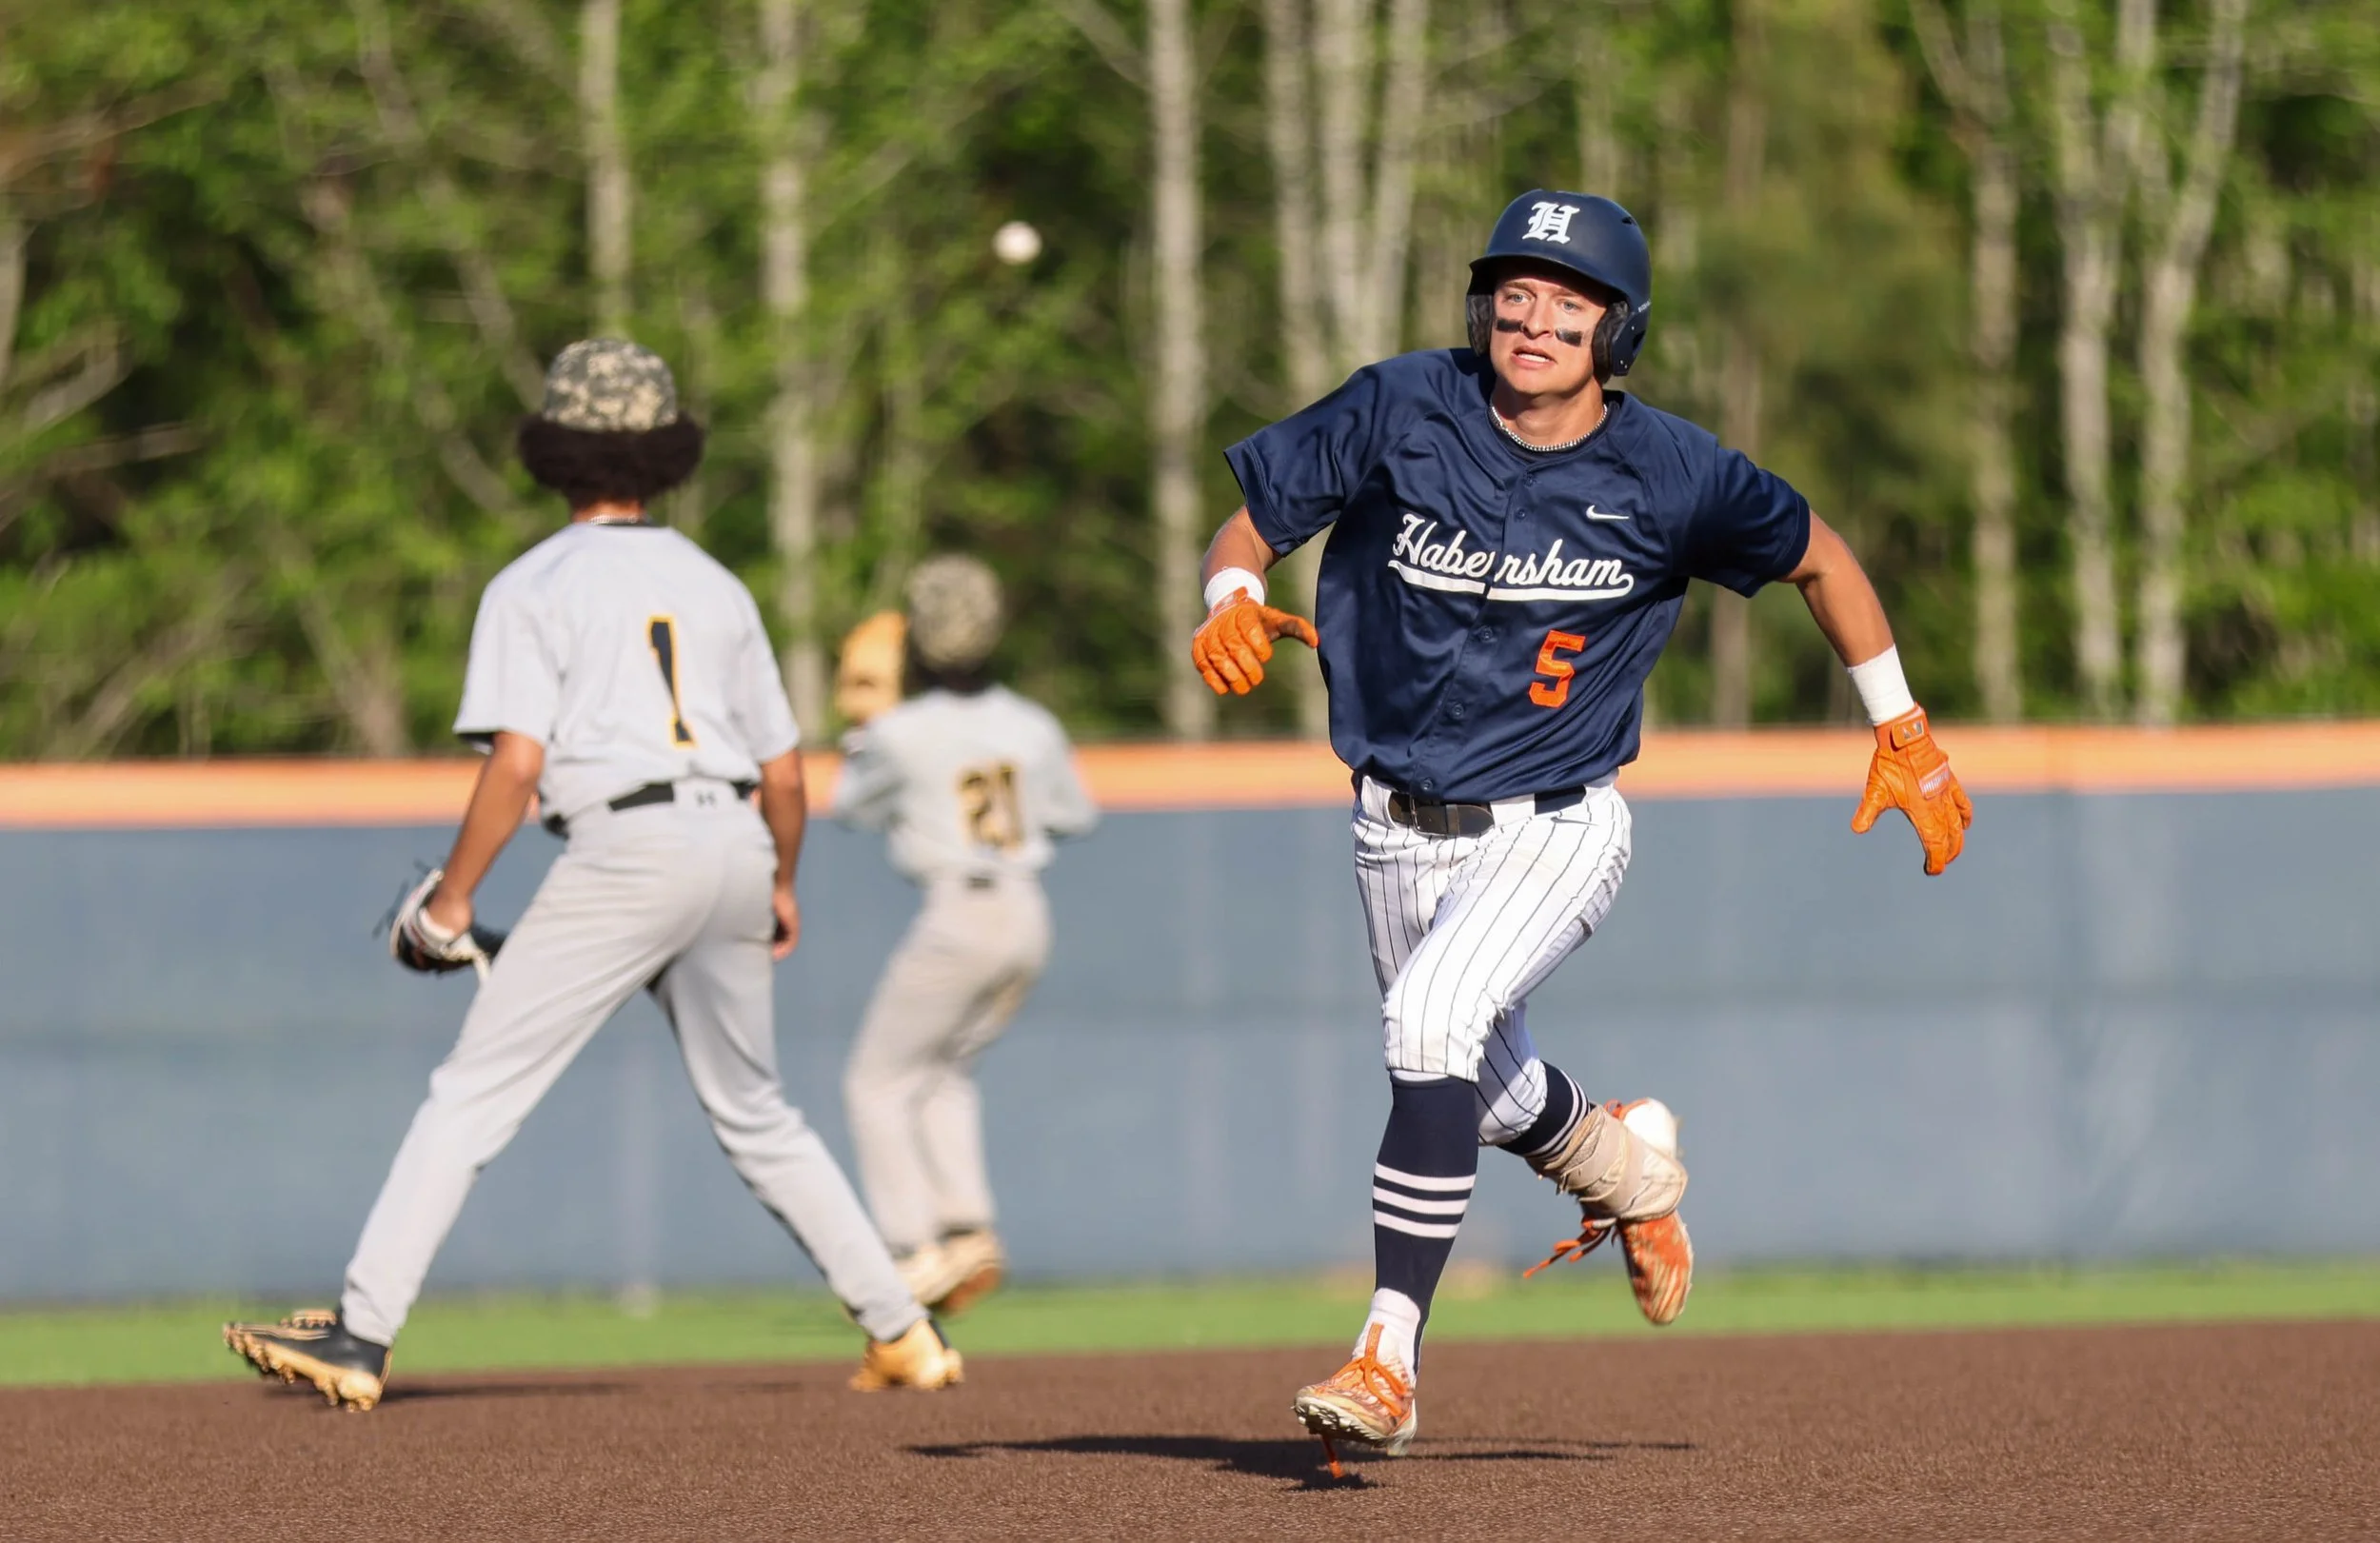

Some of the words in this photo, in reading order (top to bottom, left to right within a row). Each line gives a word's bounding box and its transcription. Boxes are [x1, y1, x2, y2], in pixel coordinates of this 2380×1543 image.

[1521, 201, 1580, 245] H
[1392, 513, 1623, 587] Habersham
[647, 616, 697, 748] 1
[1529, 630, 1586, 708] 5
